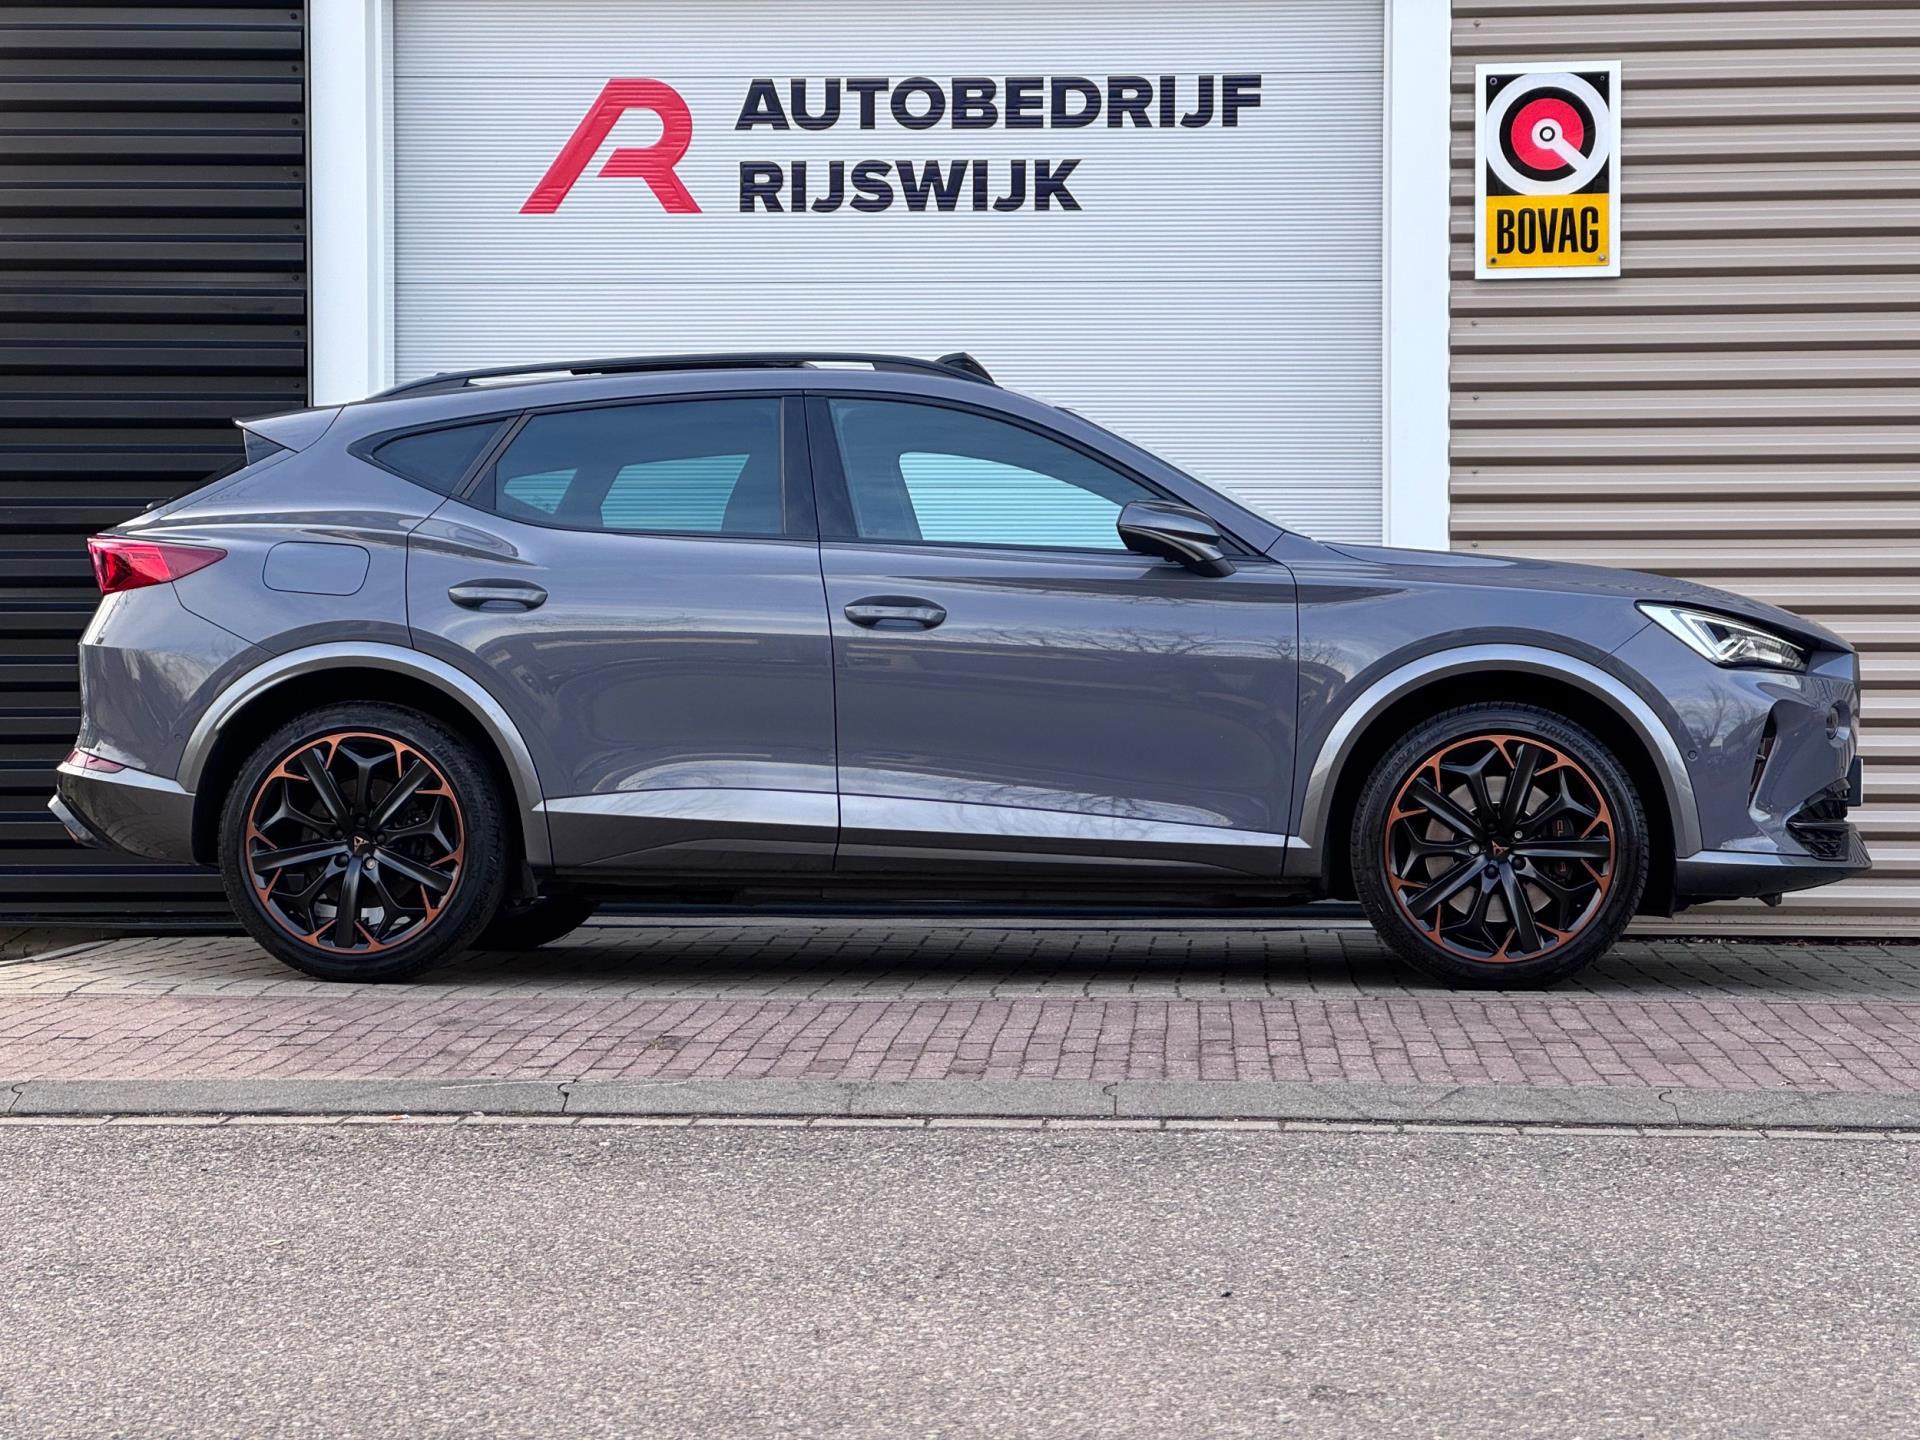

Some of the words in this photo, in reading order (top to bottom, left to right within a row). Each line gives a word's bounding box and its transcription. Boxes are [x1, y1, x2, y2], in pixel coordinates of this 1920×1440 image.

[734, 75, 1262, 130] AUTOBEDRIJF
[739, 160, 1082, 213] RIJSWIJK
[1496, 206, 1599, 255] BOVAG
